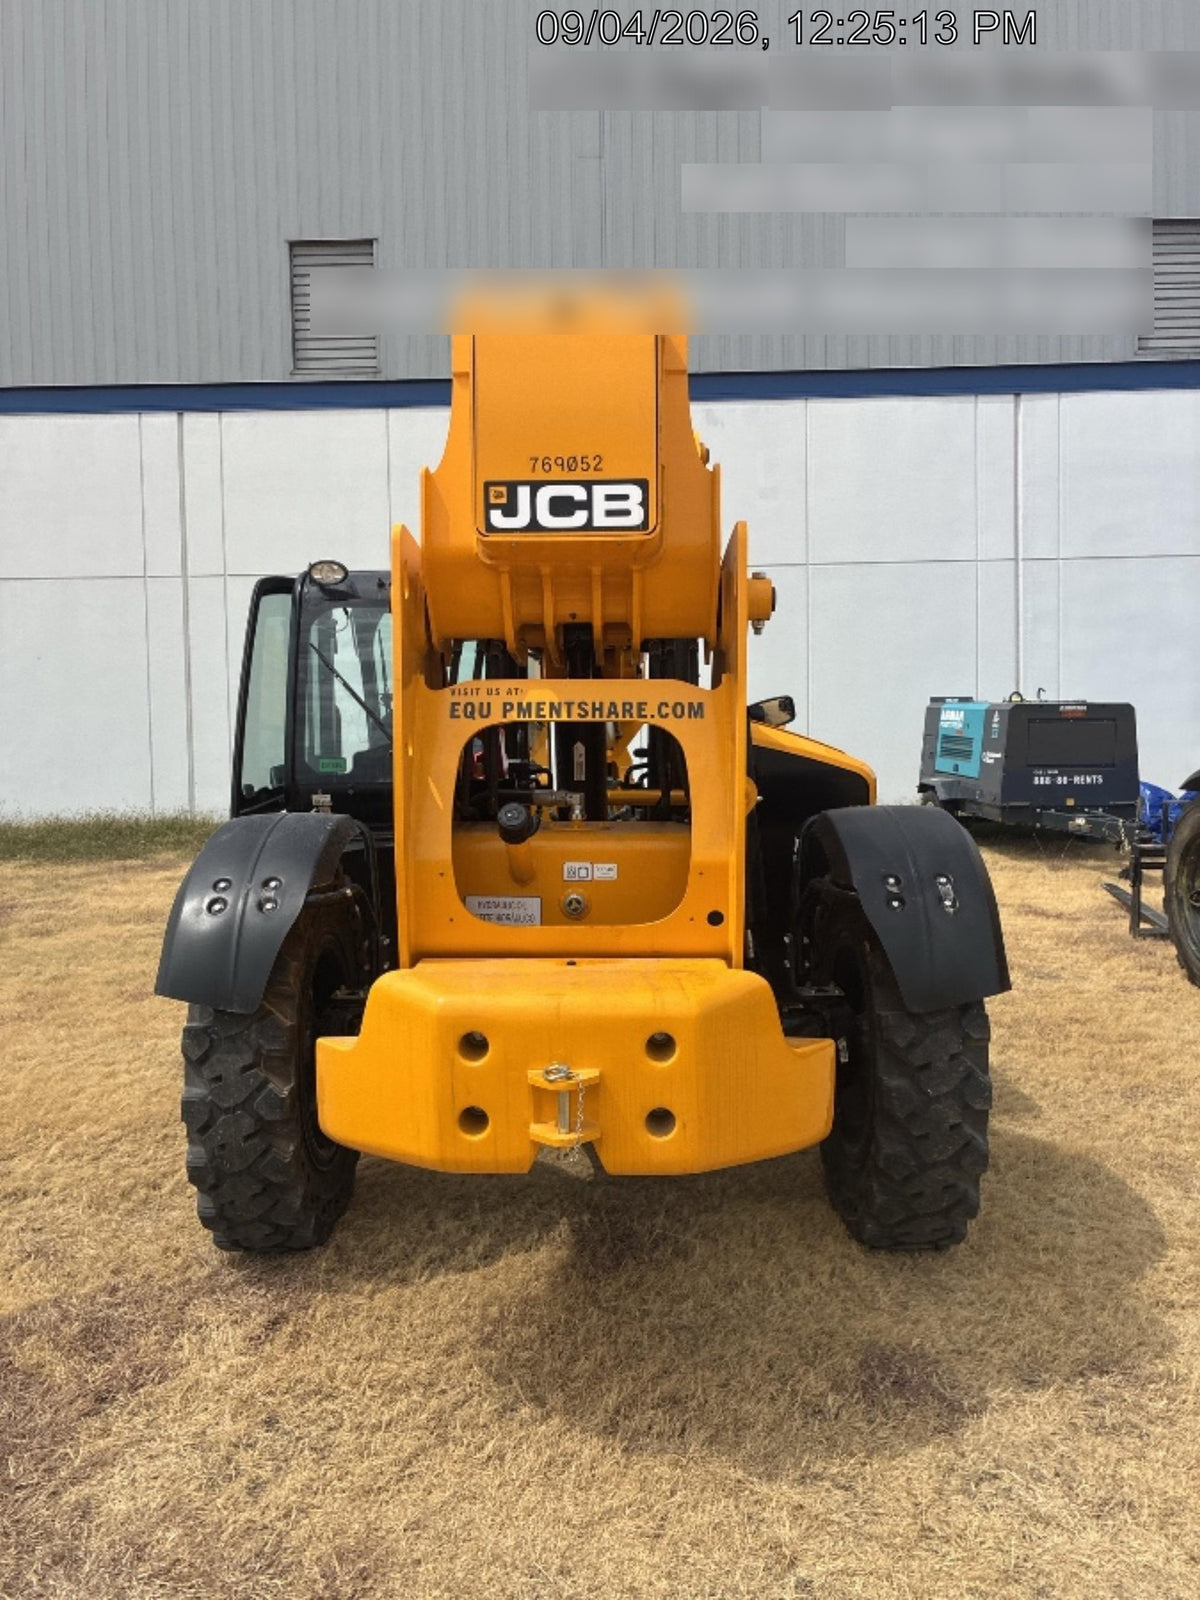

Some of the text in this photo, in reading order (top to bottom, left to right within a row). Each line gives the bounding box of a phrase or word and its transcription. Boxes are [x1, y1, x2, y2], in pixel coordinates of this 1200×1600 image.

[530, 455, 604, 473] 769052
[489, 484, 645, 529] JCB
[486, 687, 500, 696] US
[449, 701, 705, 720] EQUPMENTSHARE.COM
